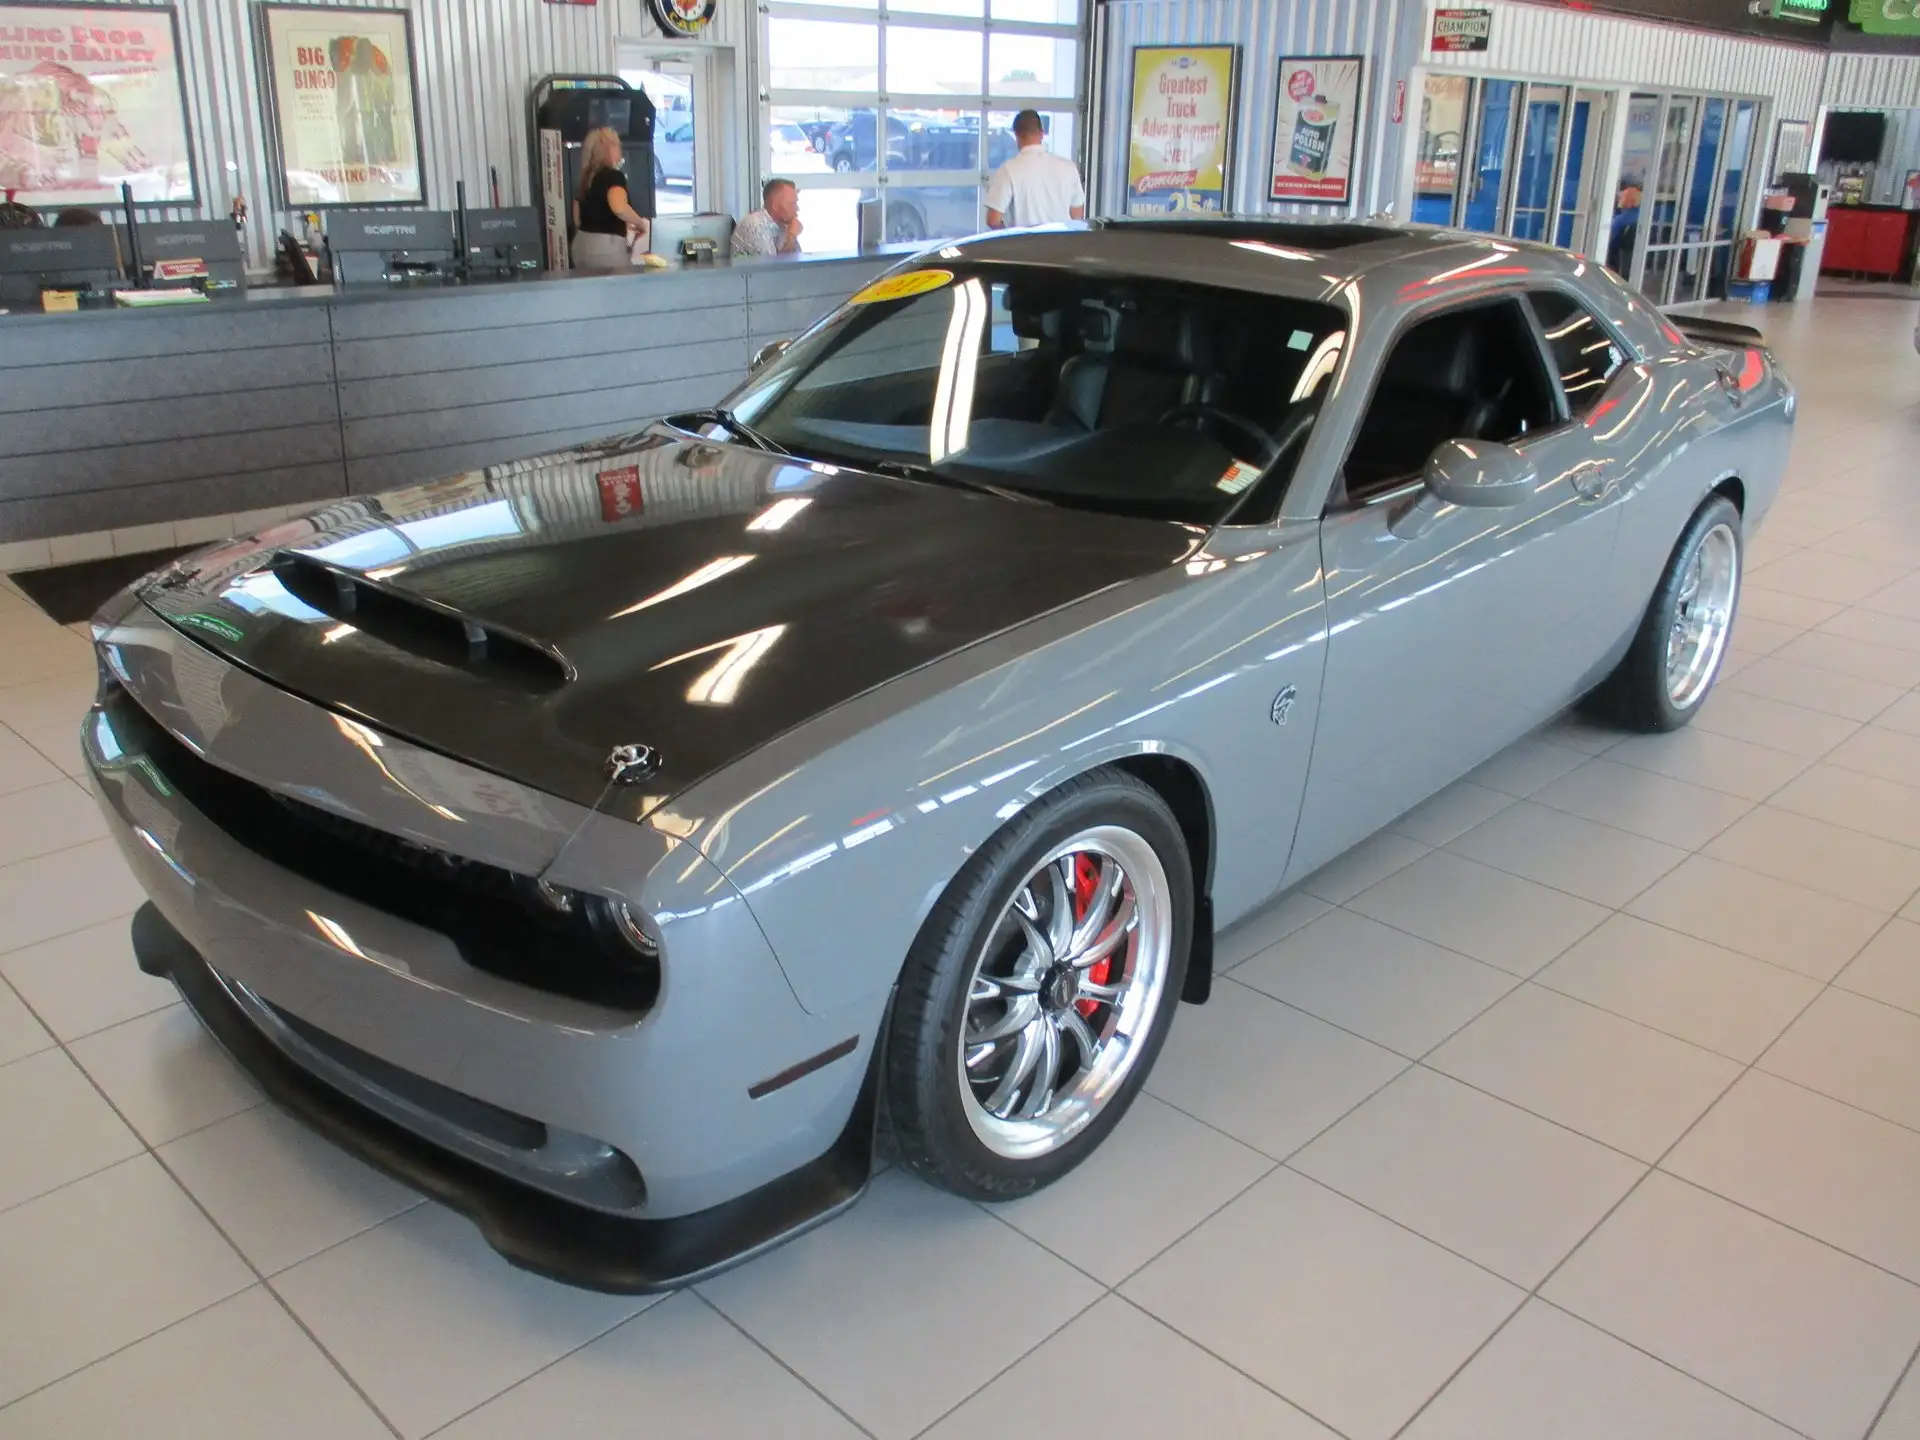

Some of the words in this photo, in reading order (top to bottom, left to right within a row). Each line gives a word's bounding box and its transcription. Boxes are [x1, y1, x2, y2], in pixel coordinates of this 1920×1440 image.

[1437, 19, 1487, 33] CHAMPION
[296, 47, 325, 66] BIG
[294, 70, 337, 90] BINGO
[1158, 72, 1208, 95] Greatest
[1167, 96, 1197, 118] Truck
[1141, 117, 1221, 140] Advancement
[1301, 127, 1321, 139] AUTO
[1294, 132, 1326, 153] POLISH
